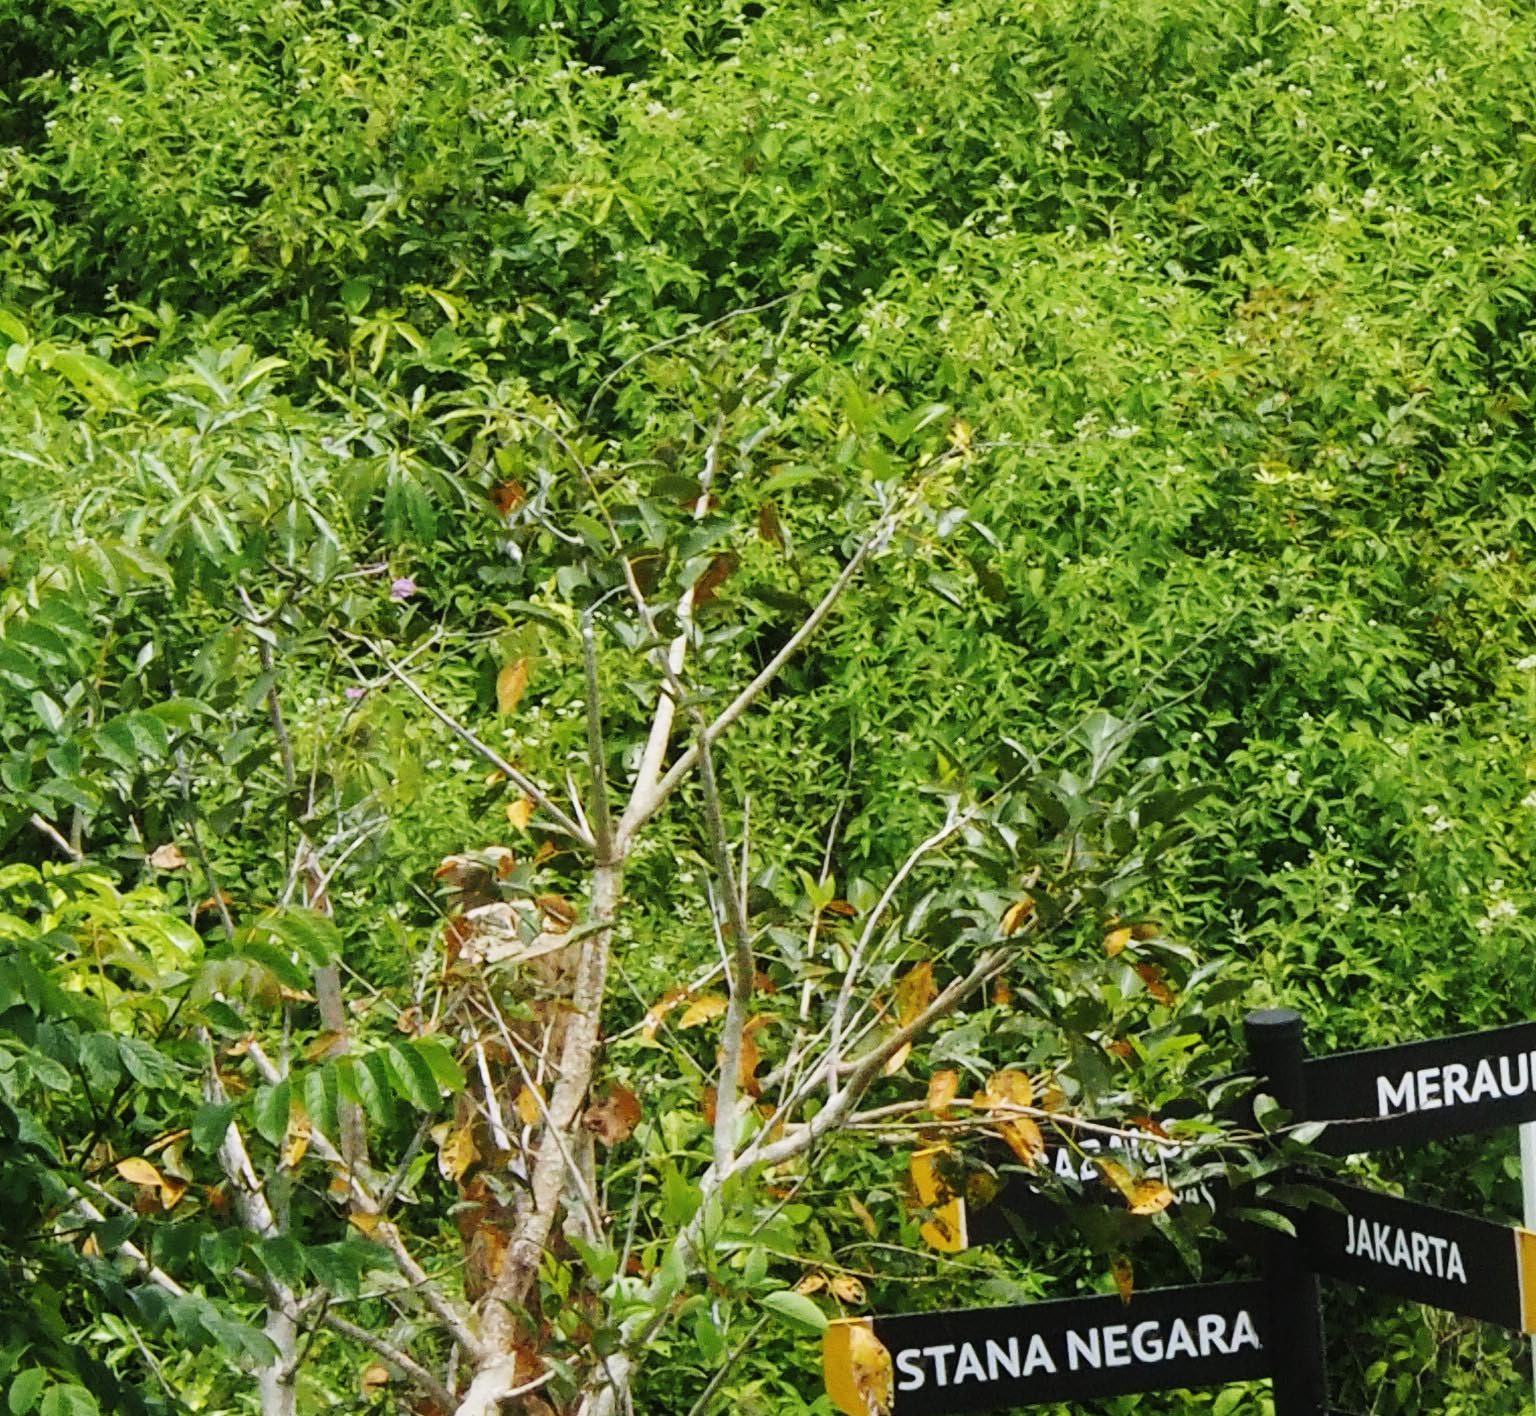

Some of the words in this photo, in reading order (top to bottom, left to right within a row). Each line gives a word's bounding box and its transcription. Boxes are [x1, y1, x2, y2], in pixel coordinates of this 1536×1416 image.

[1345, 1214, 1467, 1284] JAKARTA
[896, 1334, 1057, 1391] STANA
[1066, 1310, 1260, 1370] NEGARA
